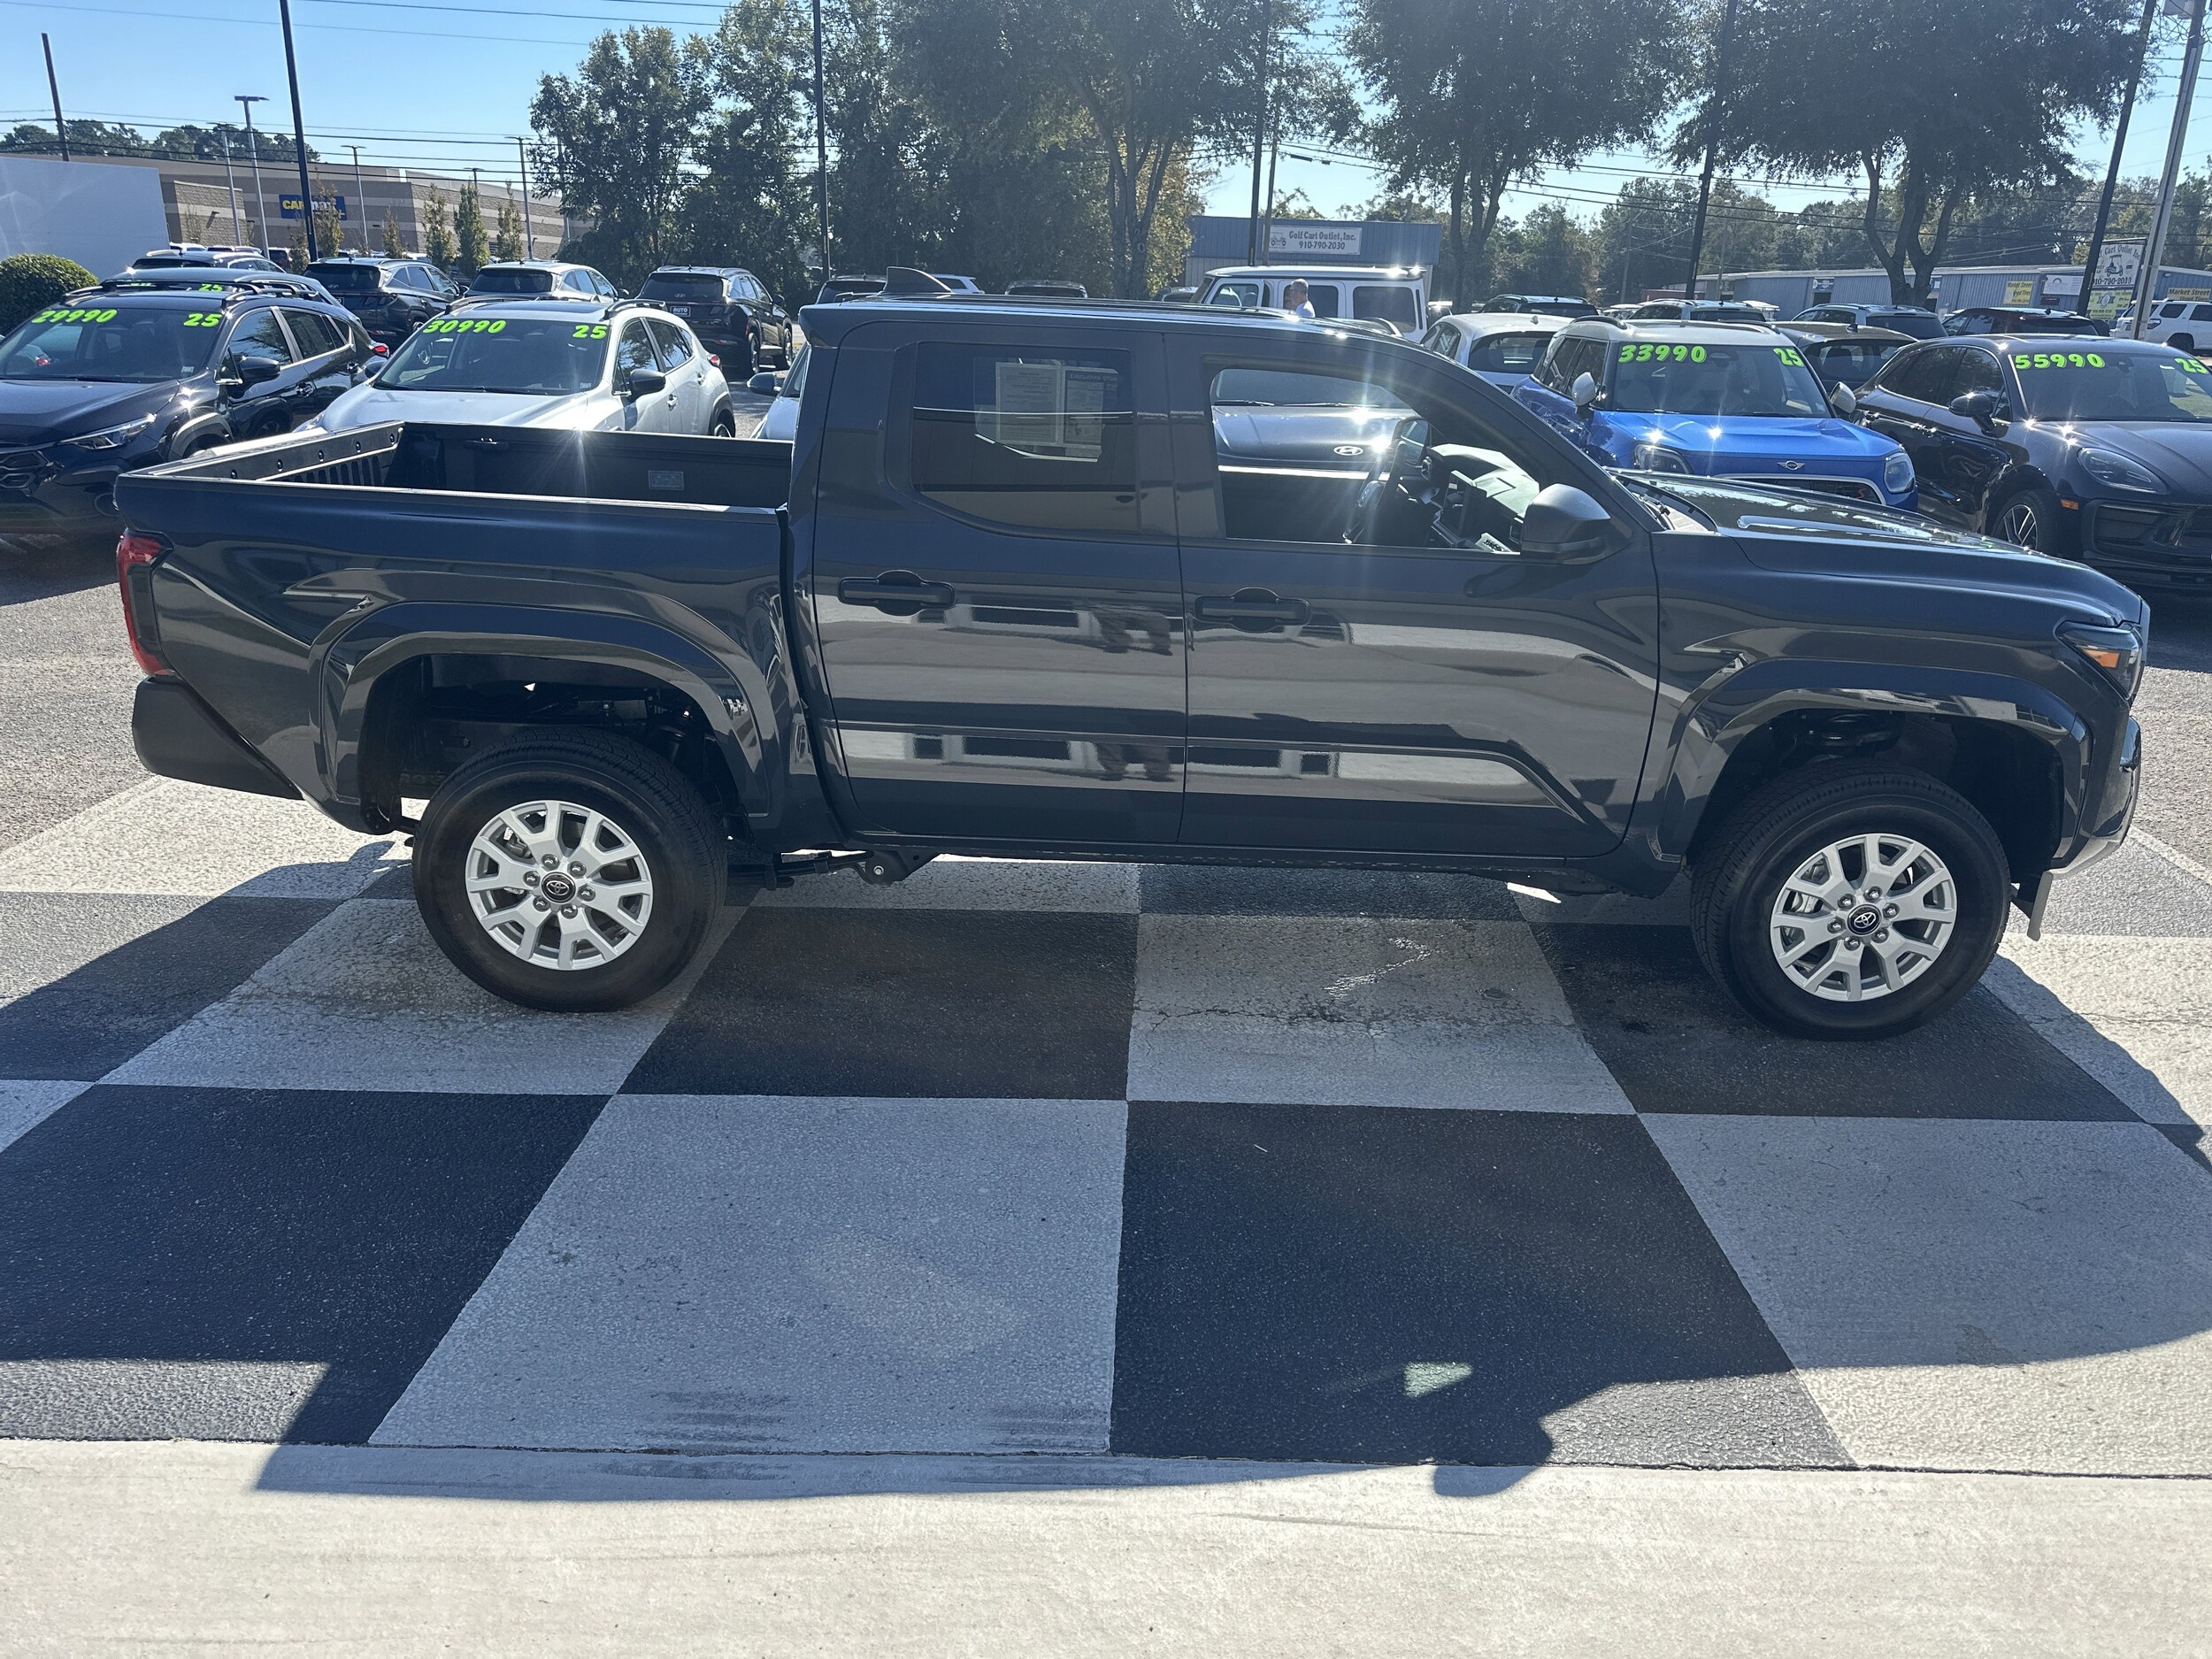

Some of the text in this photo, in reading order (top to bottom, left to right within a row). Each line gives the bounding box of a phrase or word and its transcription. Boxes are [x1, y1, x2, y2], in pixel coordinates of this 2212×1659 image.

[1288, 231, 1303, 240] Golf
[1304, 231, 1318, 240] Cart
[1318, 232, 1343, 242] Outlet,
[1299, 241, 1346, 250] 910-790-2030
[2104, 246, 2116, 255] Cart
[31, 309, 223, 327] 29990 25
[422, 319, 609, 339] 30990 25
[1617, 343, 1804, 367] 33990 25
[2015, 353, 2209, 375] 55990 25
